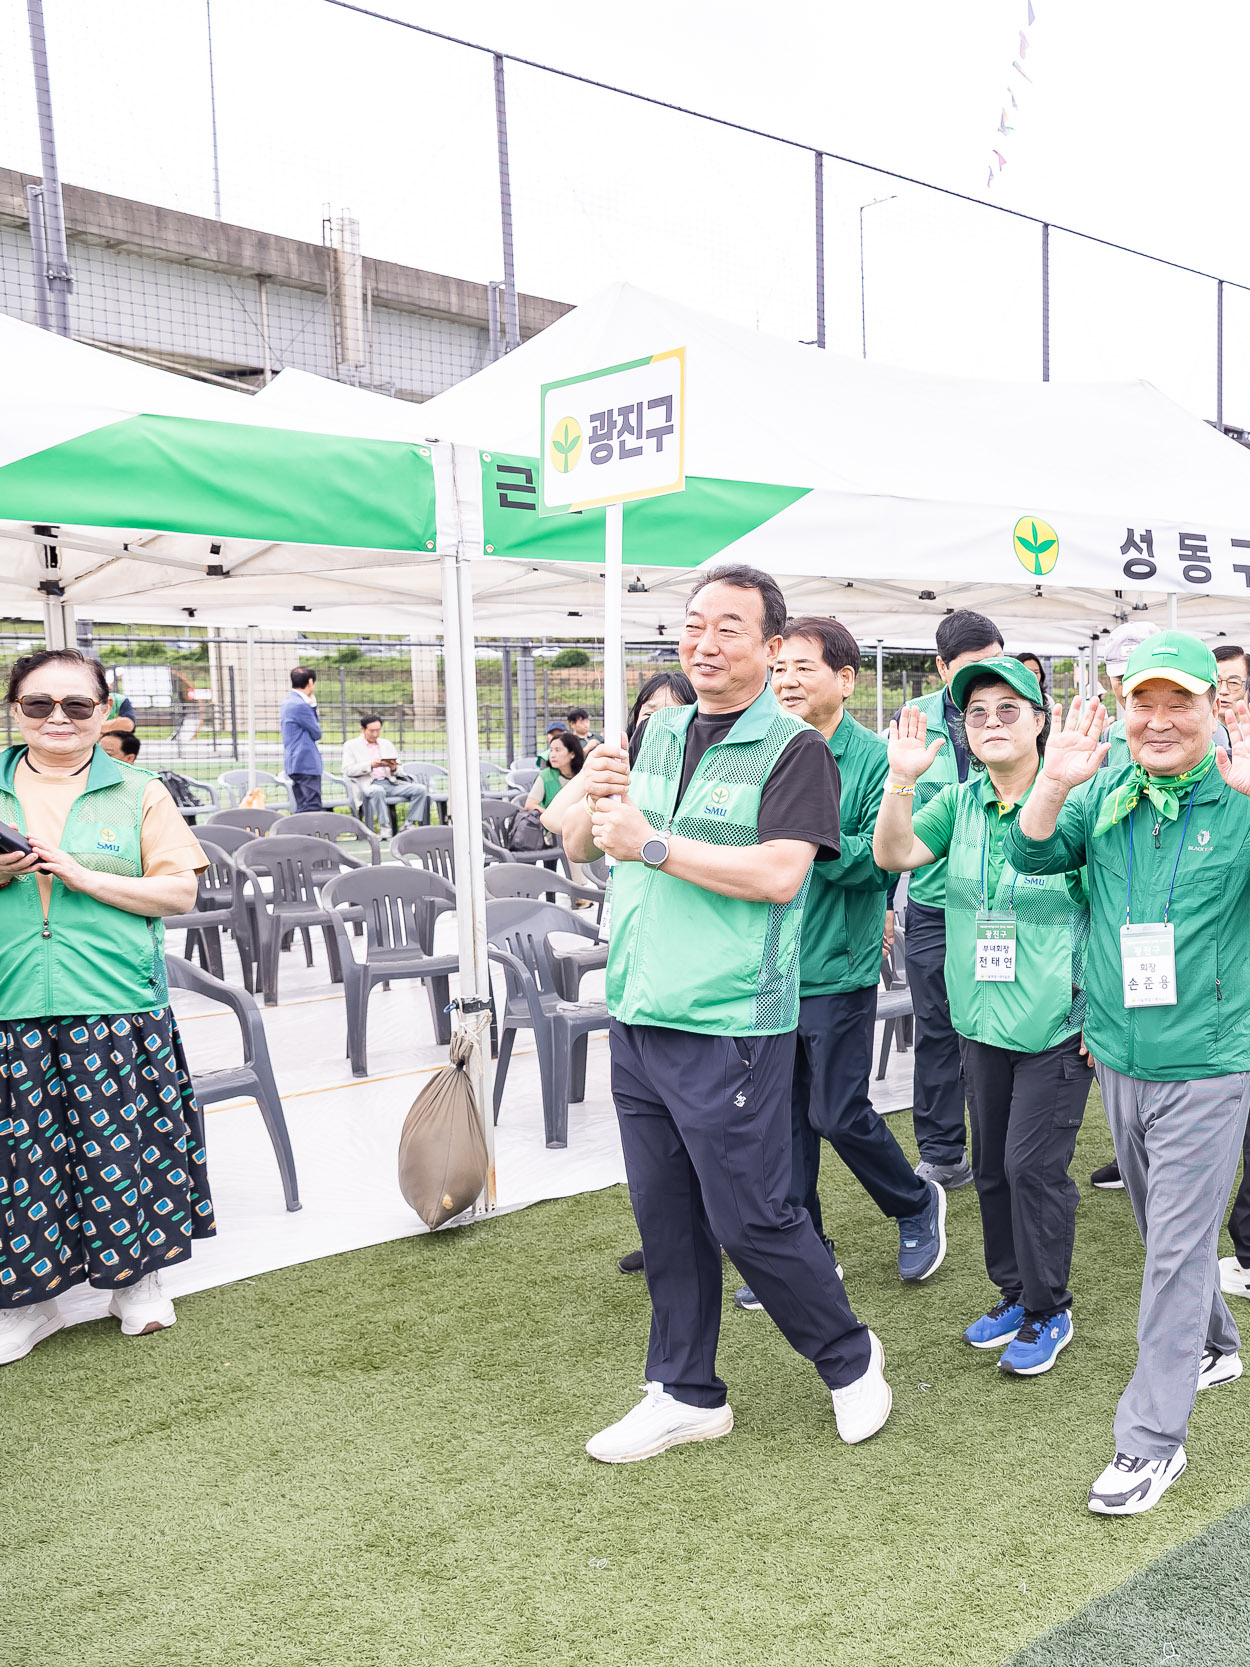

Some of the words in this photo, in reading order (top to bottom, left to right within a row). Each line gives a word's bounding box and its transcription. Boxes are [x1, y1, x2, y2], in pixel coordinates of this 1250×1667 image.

[588, 394, 675, 466] 광진구
[704, 804, 728, 817] SMU
[96, 842, 121, 852] SMU
[1024, 876, 1046, 886] SMU
[979, 957, 1013, 968] 전태연
[1140, 963, 1156, 973] 회장
[1128, 975, 1170, 991] 손준용
